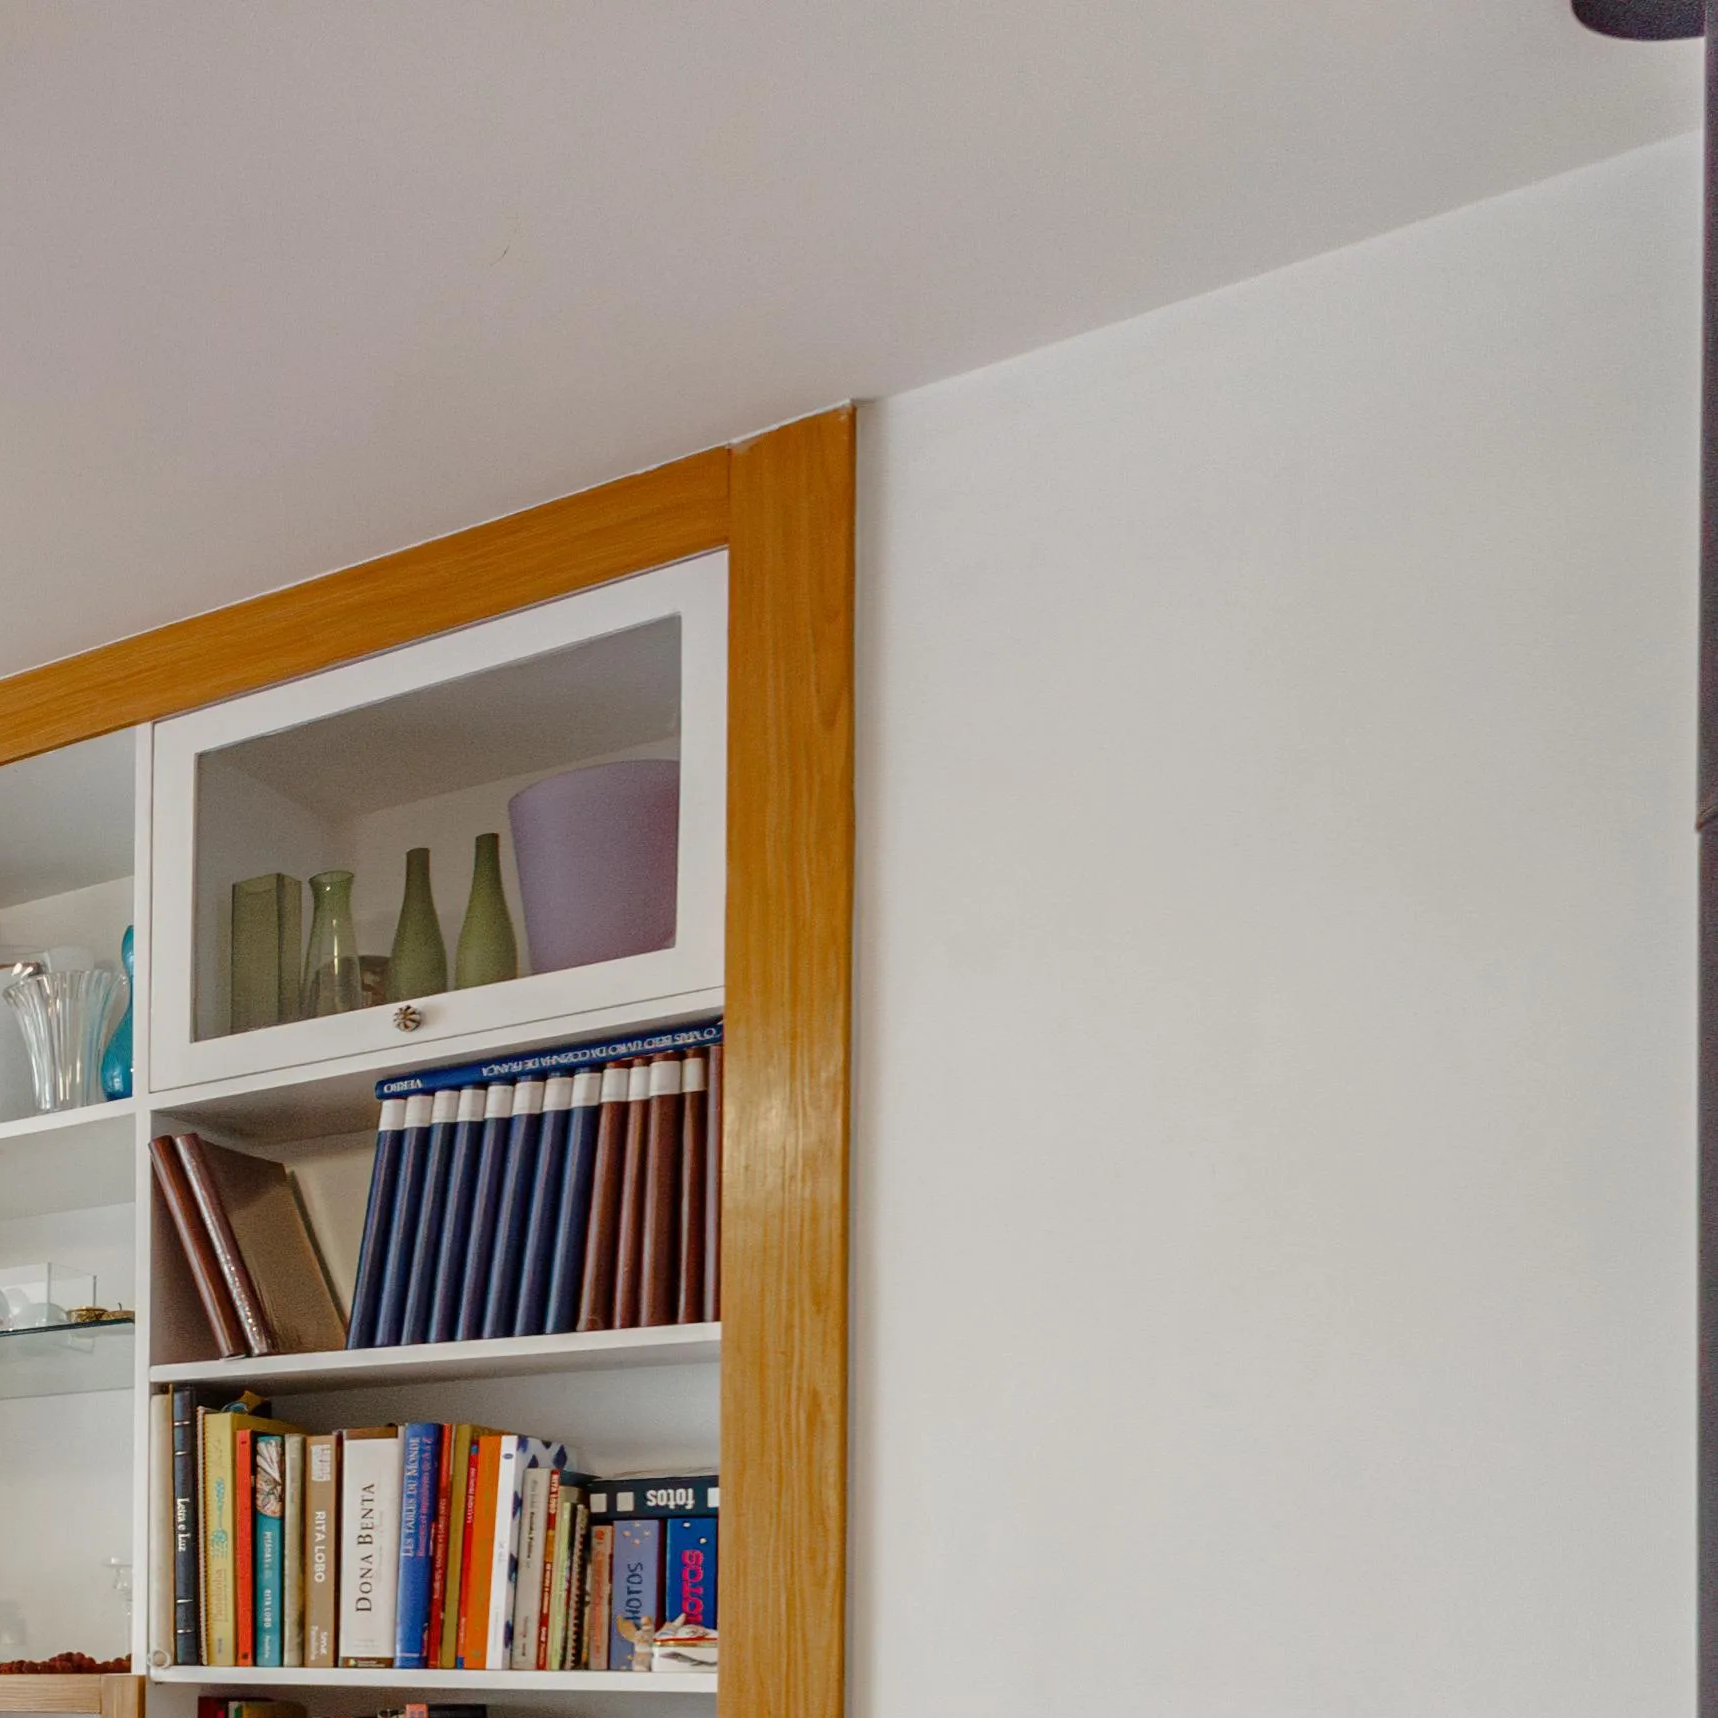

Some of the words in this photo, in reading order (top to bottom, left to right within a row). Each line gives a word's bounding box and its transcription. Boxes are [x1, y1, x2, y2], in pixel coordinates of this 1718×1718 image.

[383, 1078, 423, 1094] VERBO
[357, 1483, 375, 1545] BENTA
[646, 1488, 695, 1510] fotos
[315, 1510, 326, 1542] RITA
[314, 1544, 326, 1583] LOBO
[355, 1554, 373, 1613] DONA
